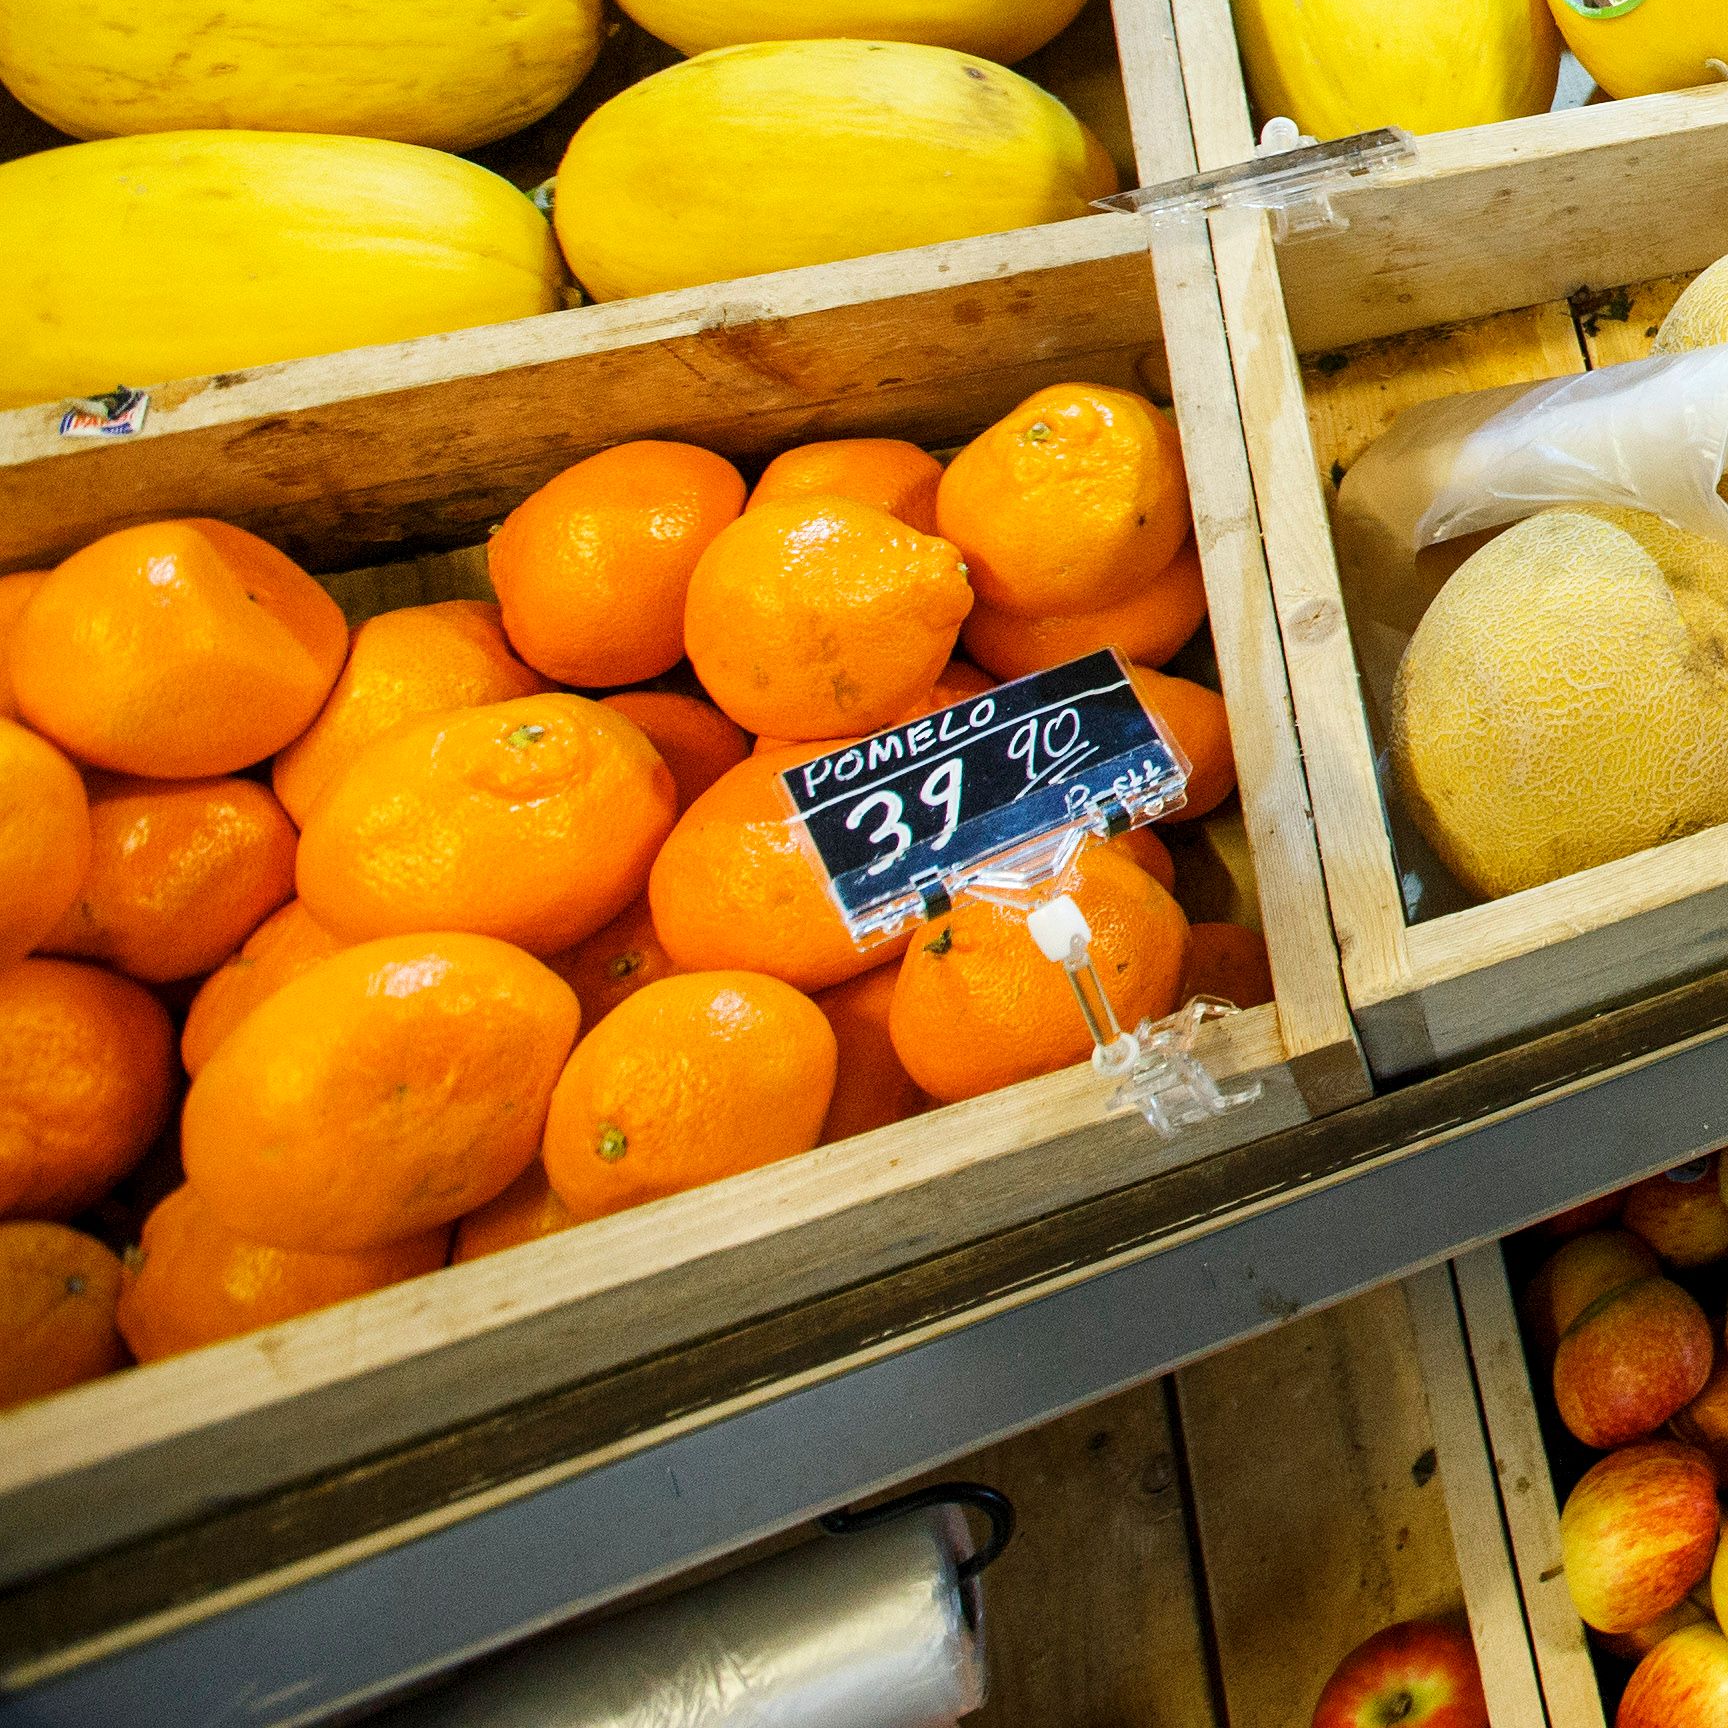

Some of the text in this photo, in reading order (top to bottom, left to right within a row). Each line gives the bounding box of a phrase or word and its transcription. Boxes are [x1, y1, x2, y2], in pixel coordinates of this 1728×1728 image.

[803, 697, 996, 798] POMELO
[845, 707, 1081, 875] 39 90
